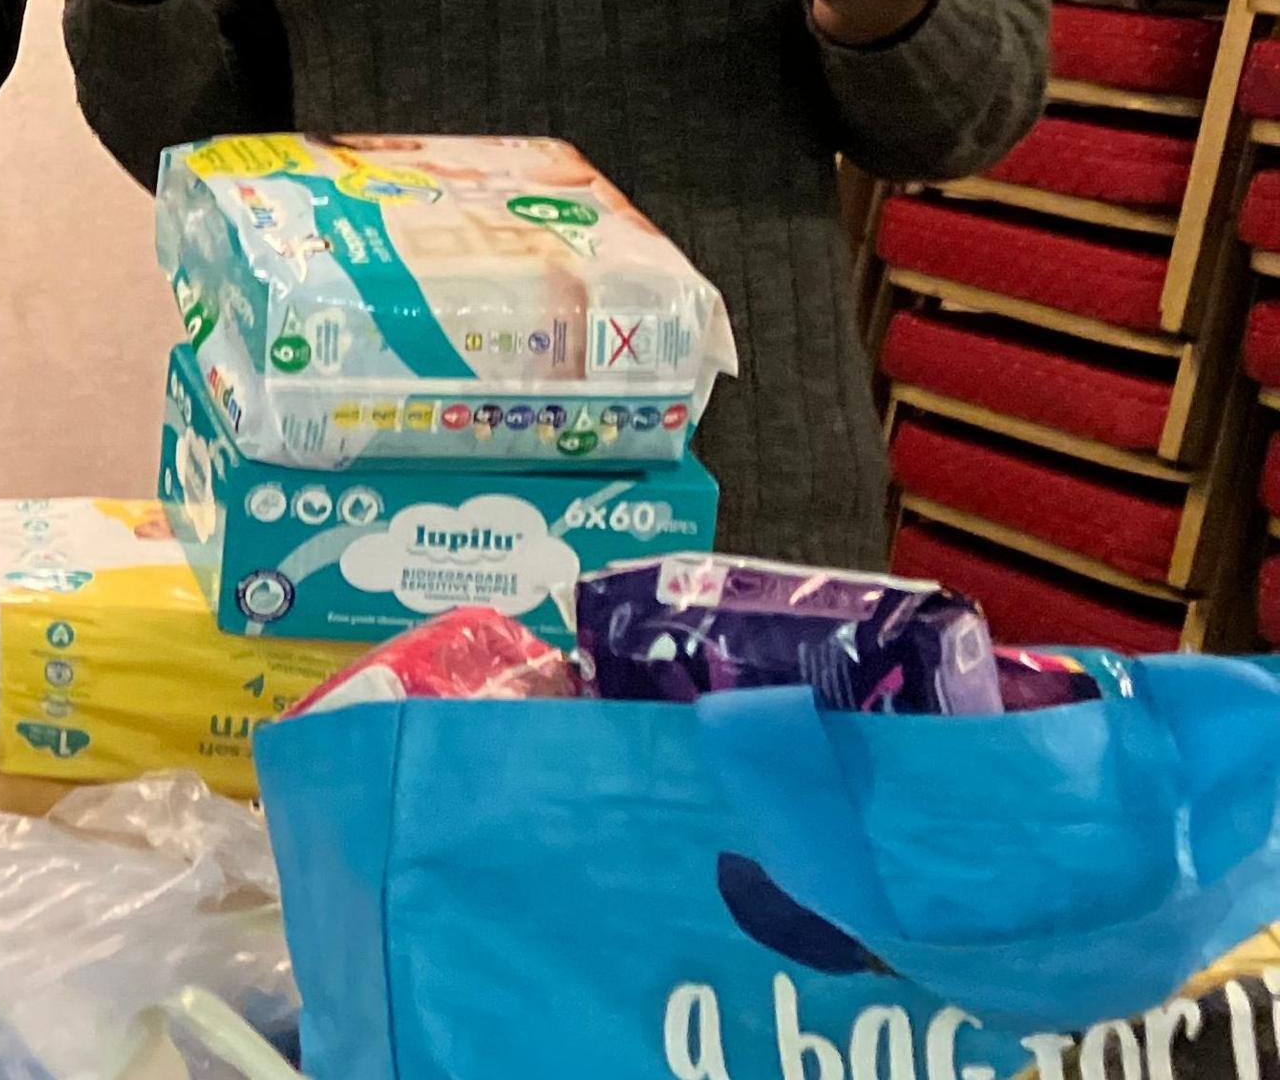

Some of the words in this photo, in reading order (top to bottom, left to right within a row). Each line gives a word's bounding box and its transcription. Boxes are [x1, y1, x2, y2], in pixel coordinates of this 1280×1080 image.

[273, 345, 294, 363] 6
[414, 524, 514, 552] lupilu
[401, 568, 518, 584] BIODEGRADABLE
[400, 580, 469, 592] SENSITIVE
[474, 583, 518, 596] WIPES
[664, 982, 730, 1080] a
